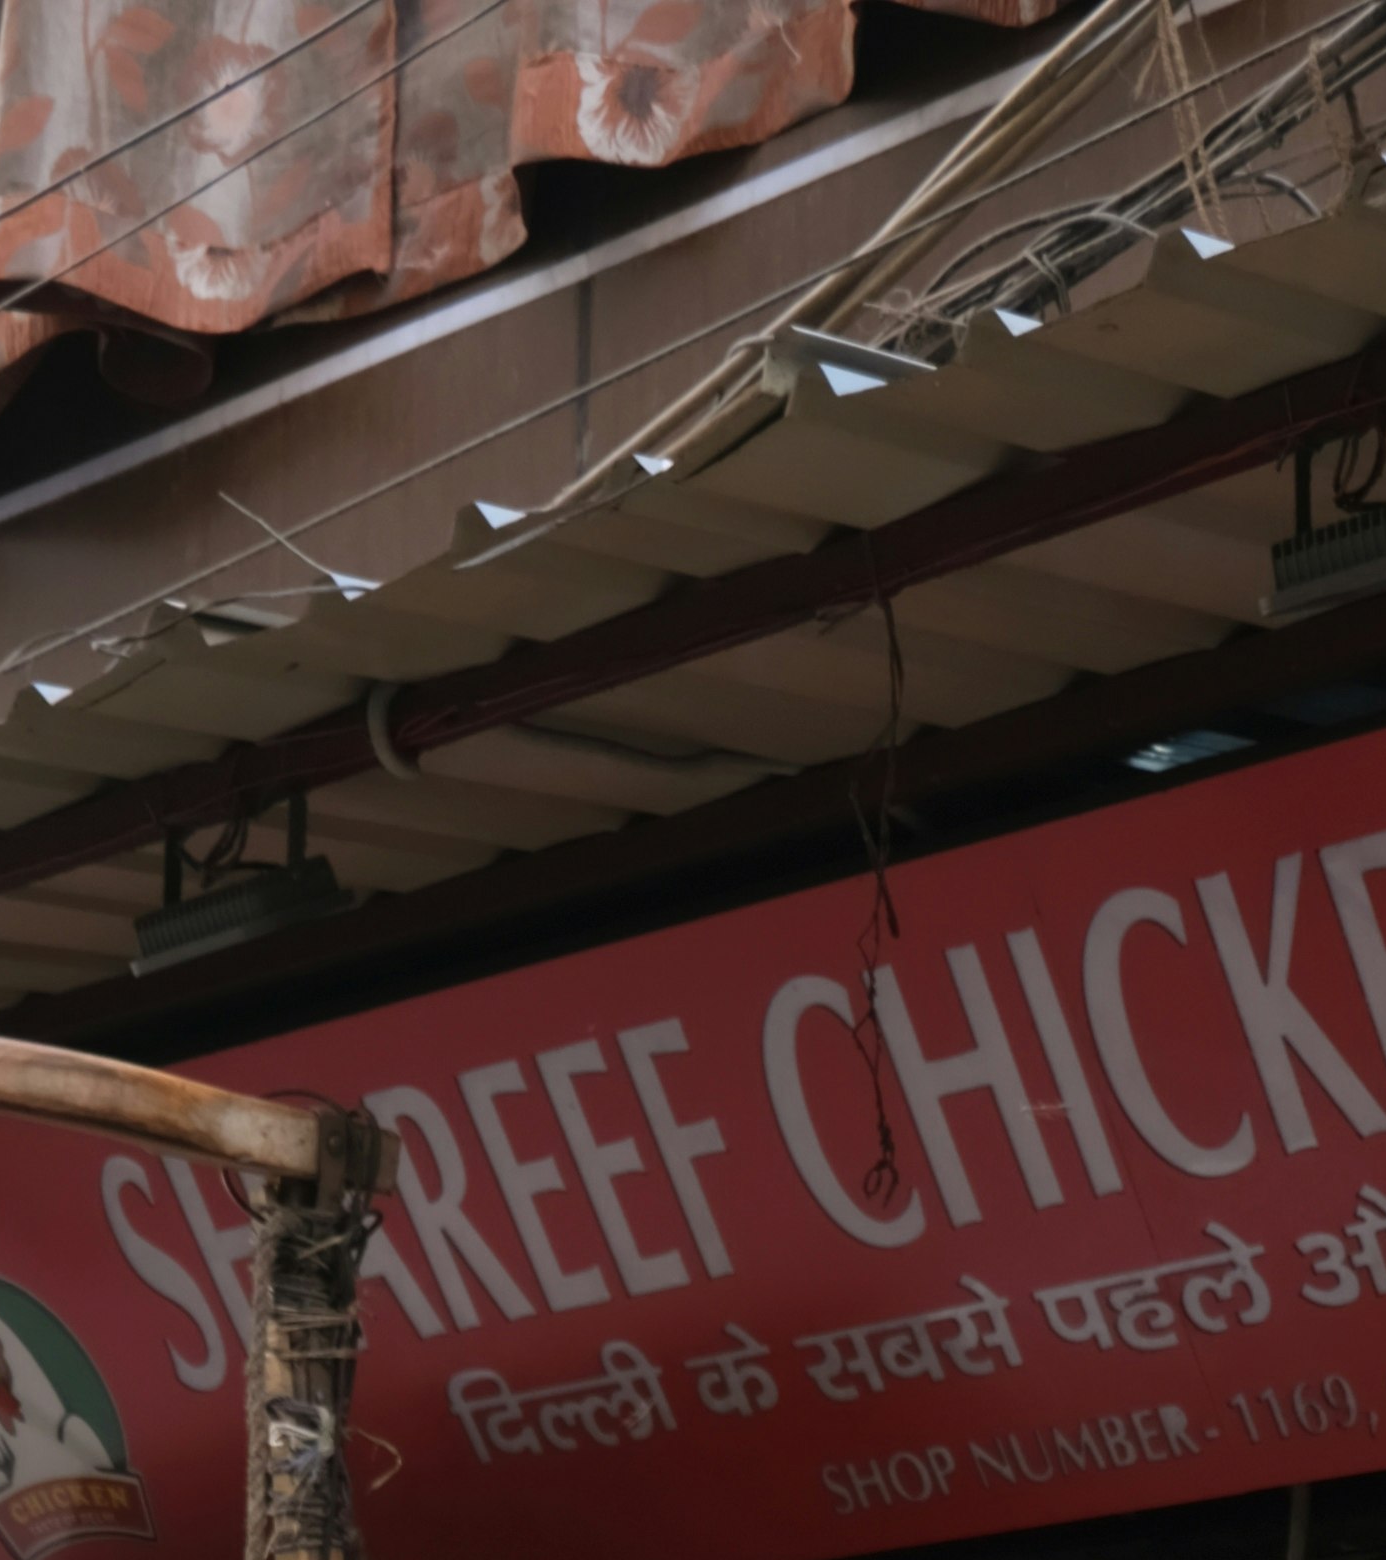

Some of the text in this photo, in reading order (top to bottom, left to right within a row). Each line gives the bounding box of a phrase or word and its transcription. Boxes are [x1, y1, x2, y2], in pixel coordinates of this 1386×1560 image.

[448, 1338, 679, 1465] दिल्ली
[685, 1322, 781, 1418] के
[793, 1274, 1025, 1404] सबसे
[1033, 1220, 1277, 1354] पहले
[9, 1484, 133, 1526] CHICKEN
[818, 1445, 961, 1518] SHOP
[1225, 1372, 1381, 1448] 1169,
